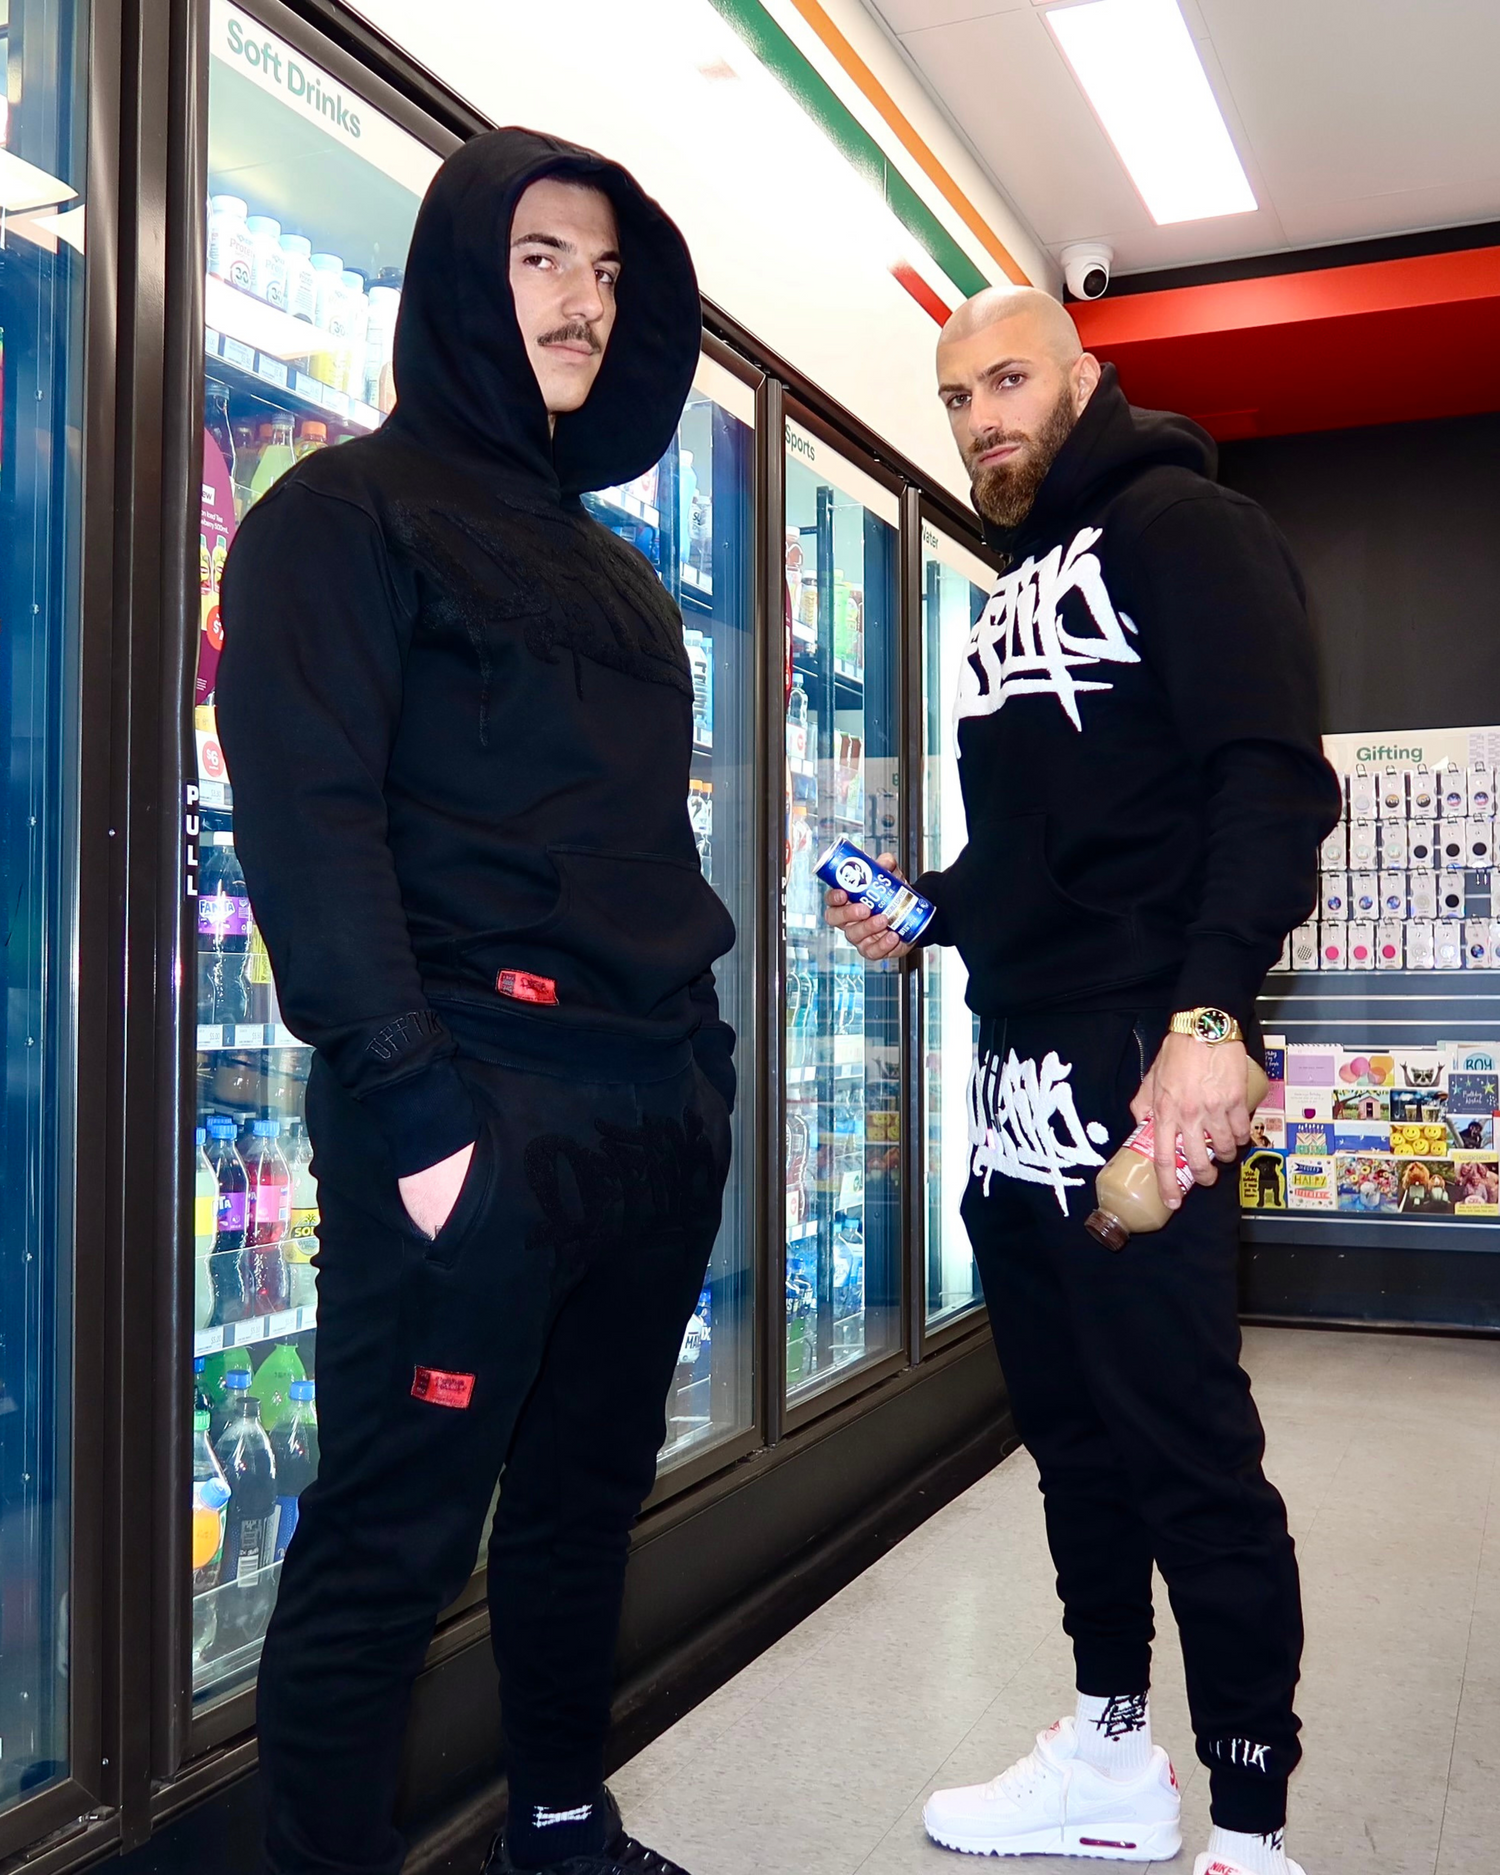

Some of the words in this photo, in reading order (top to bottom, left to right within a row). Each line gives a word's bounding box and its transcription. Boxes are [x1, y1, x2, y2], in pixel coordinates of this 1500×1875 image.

[227, 19, 281, 84] Soft
[287, 60, 361, 138] Drinks
[785, 423, 815, 461] Sports
[1356, 745, 1423, 763] Gifting
[186, 784, 199, 896] PULL
[859, 873, 892, 910] BOSS
[878, 887, 895, 909] COFFEE
[1466, 1058, 1493, 1071] BOY
[1210, 1861, 1236, 1875] NIKE
